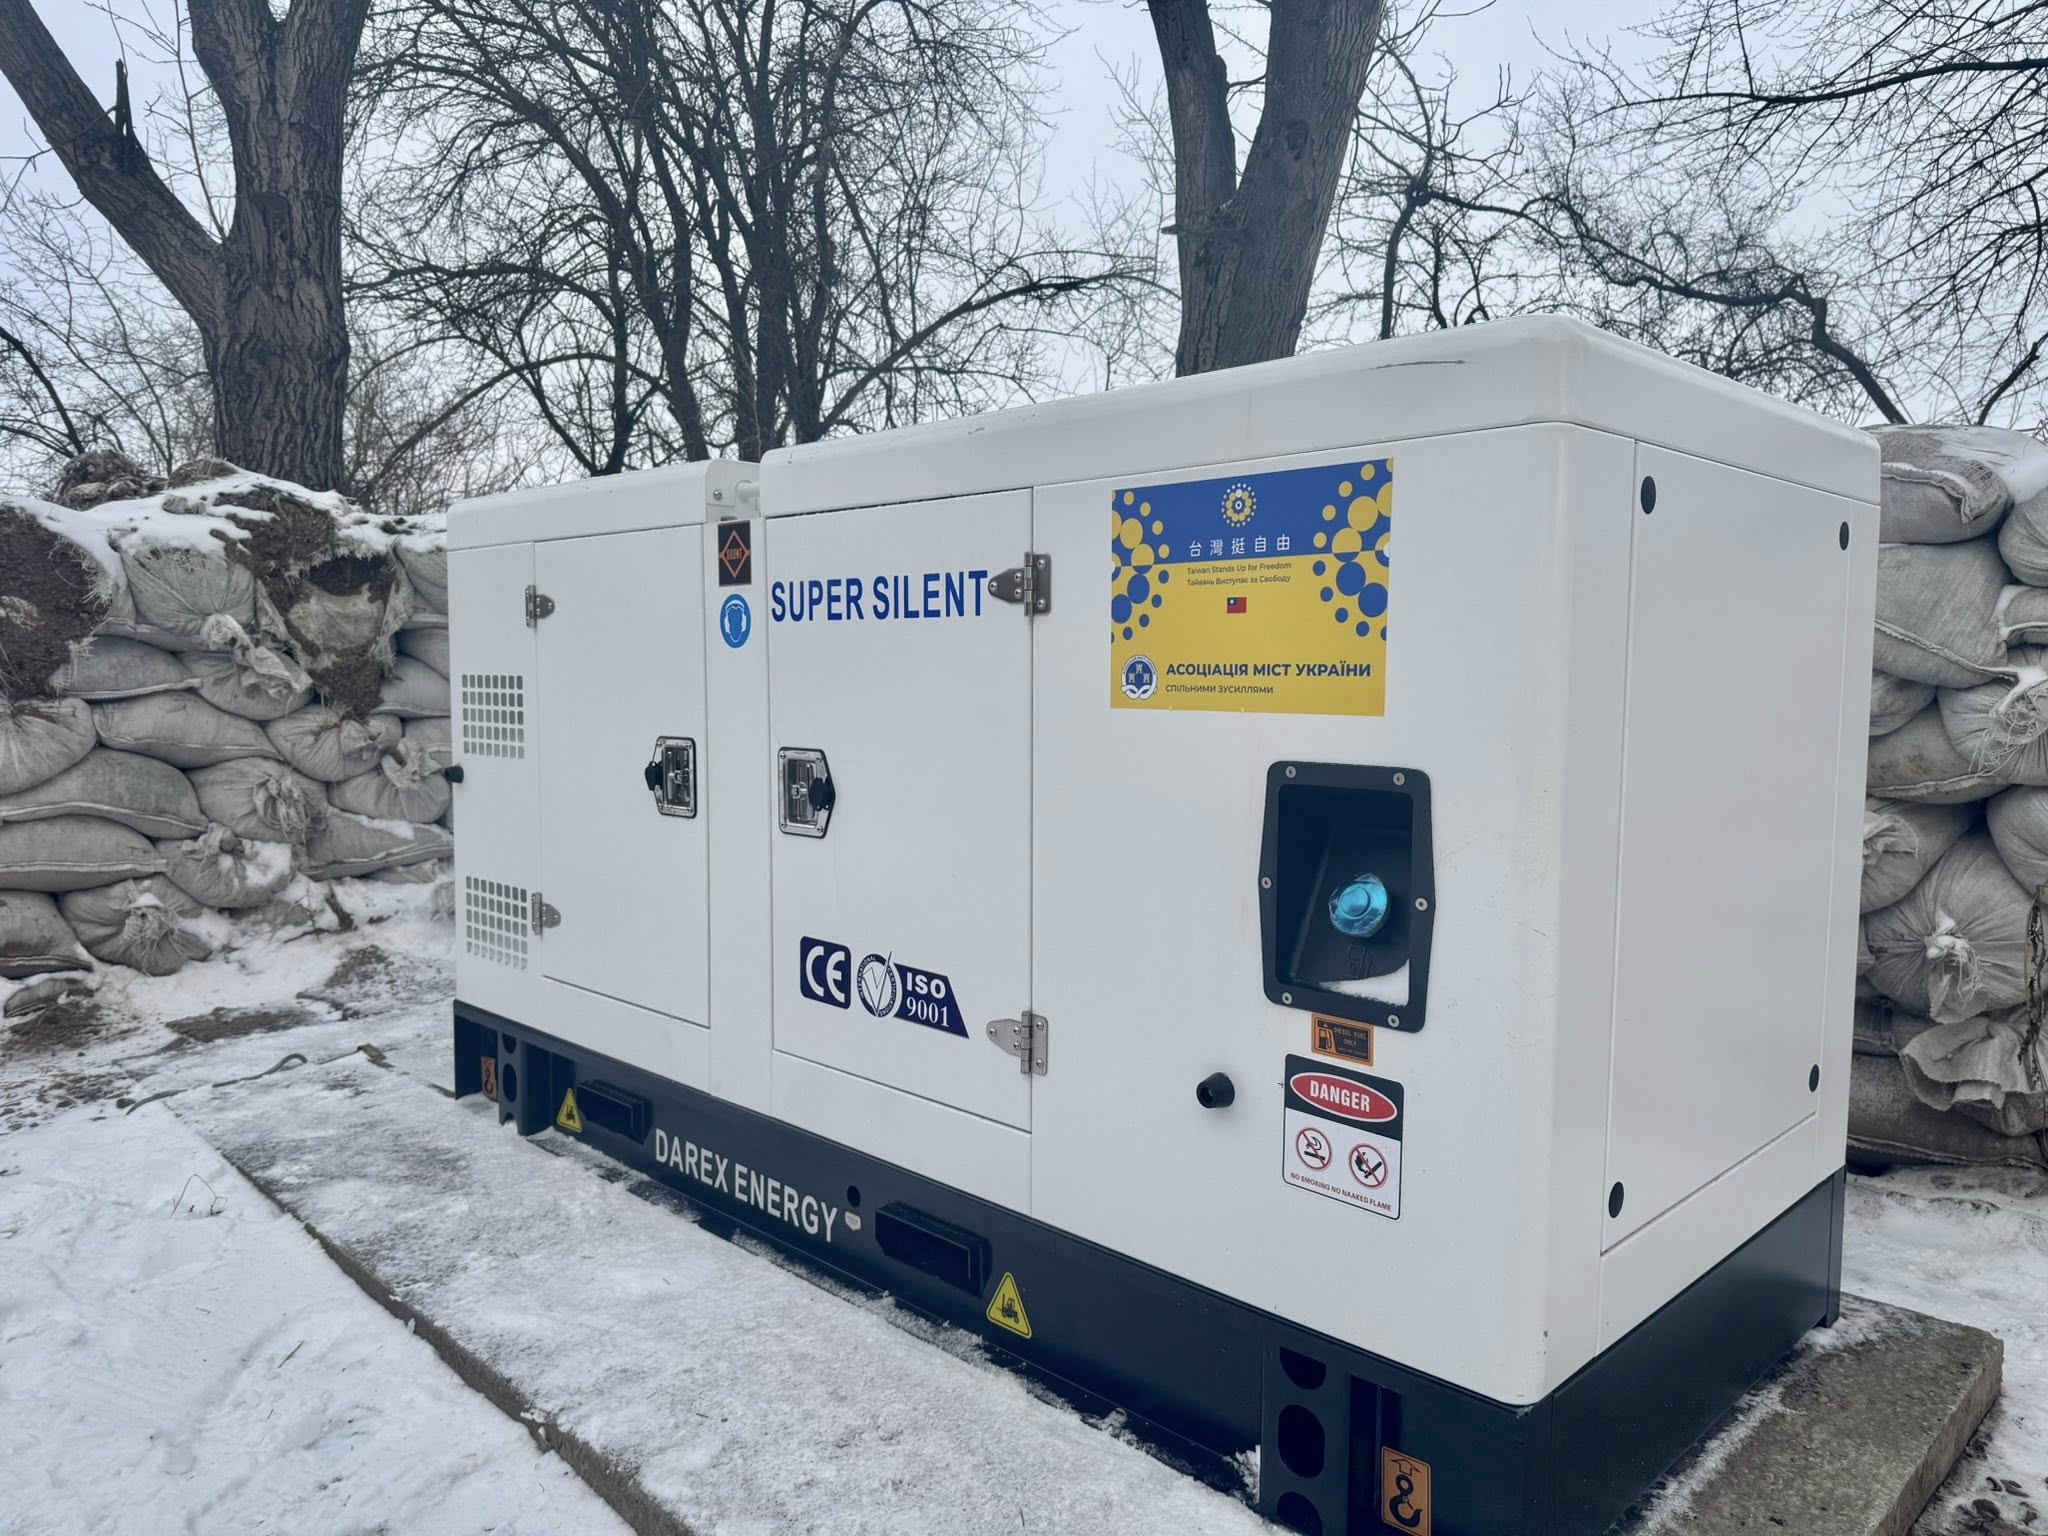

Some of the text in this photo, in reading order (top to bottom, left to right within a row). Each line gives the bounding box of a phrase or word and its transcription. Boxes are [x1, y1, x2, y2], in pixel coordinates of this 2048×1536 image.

[726, 548, 743, 560] SILENT
[1188, 533, 1291, 558] 台灣挺自由
[1187, 562, 1292, 575] Taiwan Stands Up for Freedom
[1187, 578, 1215, 587] Тайвань
[1259, 574, 1292, 584] Свободу
[771, 569, 989, 623] SUPER SILENT
[1166, 663, 1249, 678] АСОЦІАЦІЯ
[1253, 663, 1292, 677] МІСТ
[1295, 661, 1371, 677] УКРАЇНИ
[1165, 684, 1274, 694] СПІЛЬНИМИ ЗУСИЛЛЯМИ
[805, 945, 846, 1003] CE
[906, 971, 946, 999] ISO
[906, 996, 950, 1028] 9001
[1310, 1080, 1371, 1113] DANGER
[655, 1128, 838, 1242] DAREX ENERGY
[1290, 1172, 1392, 1212] NO SMOKING NO NAAKED FLAME
